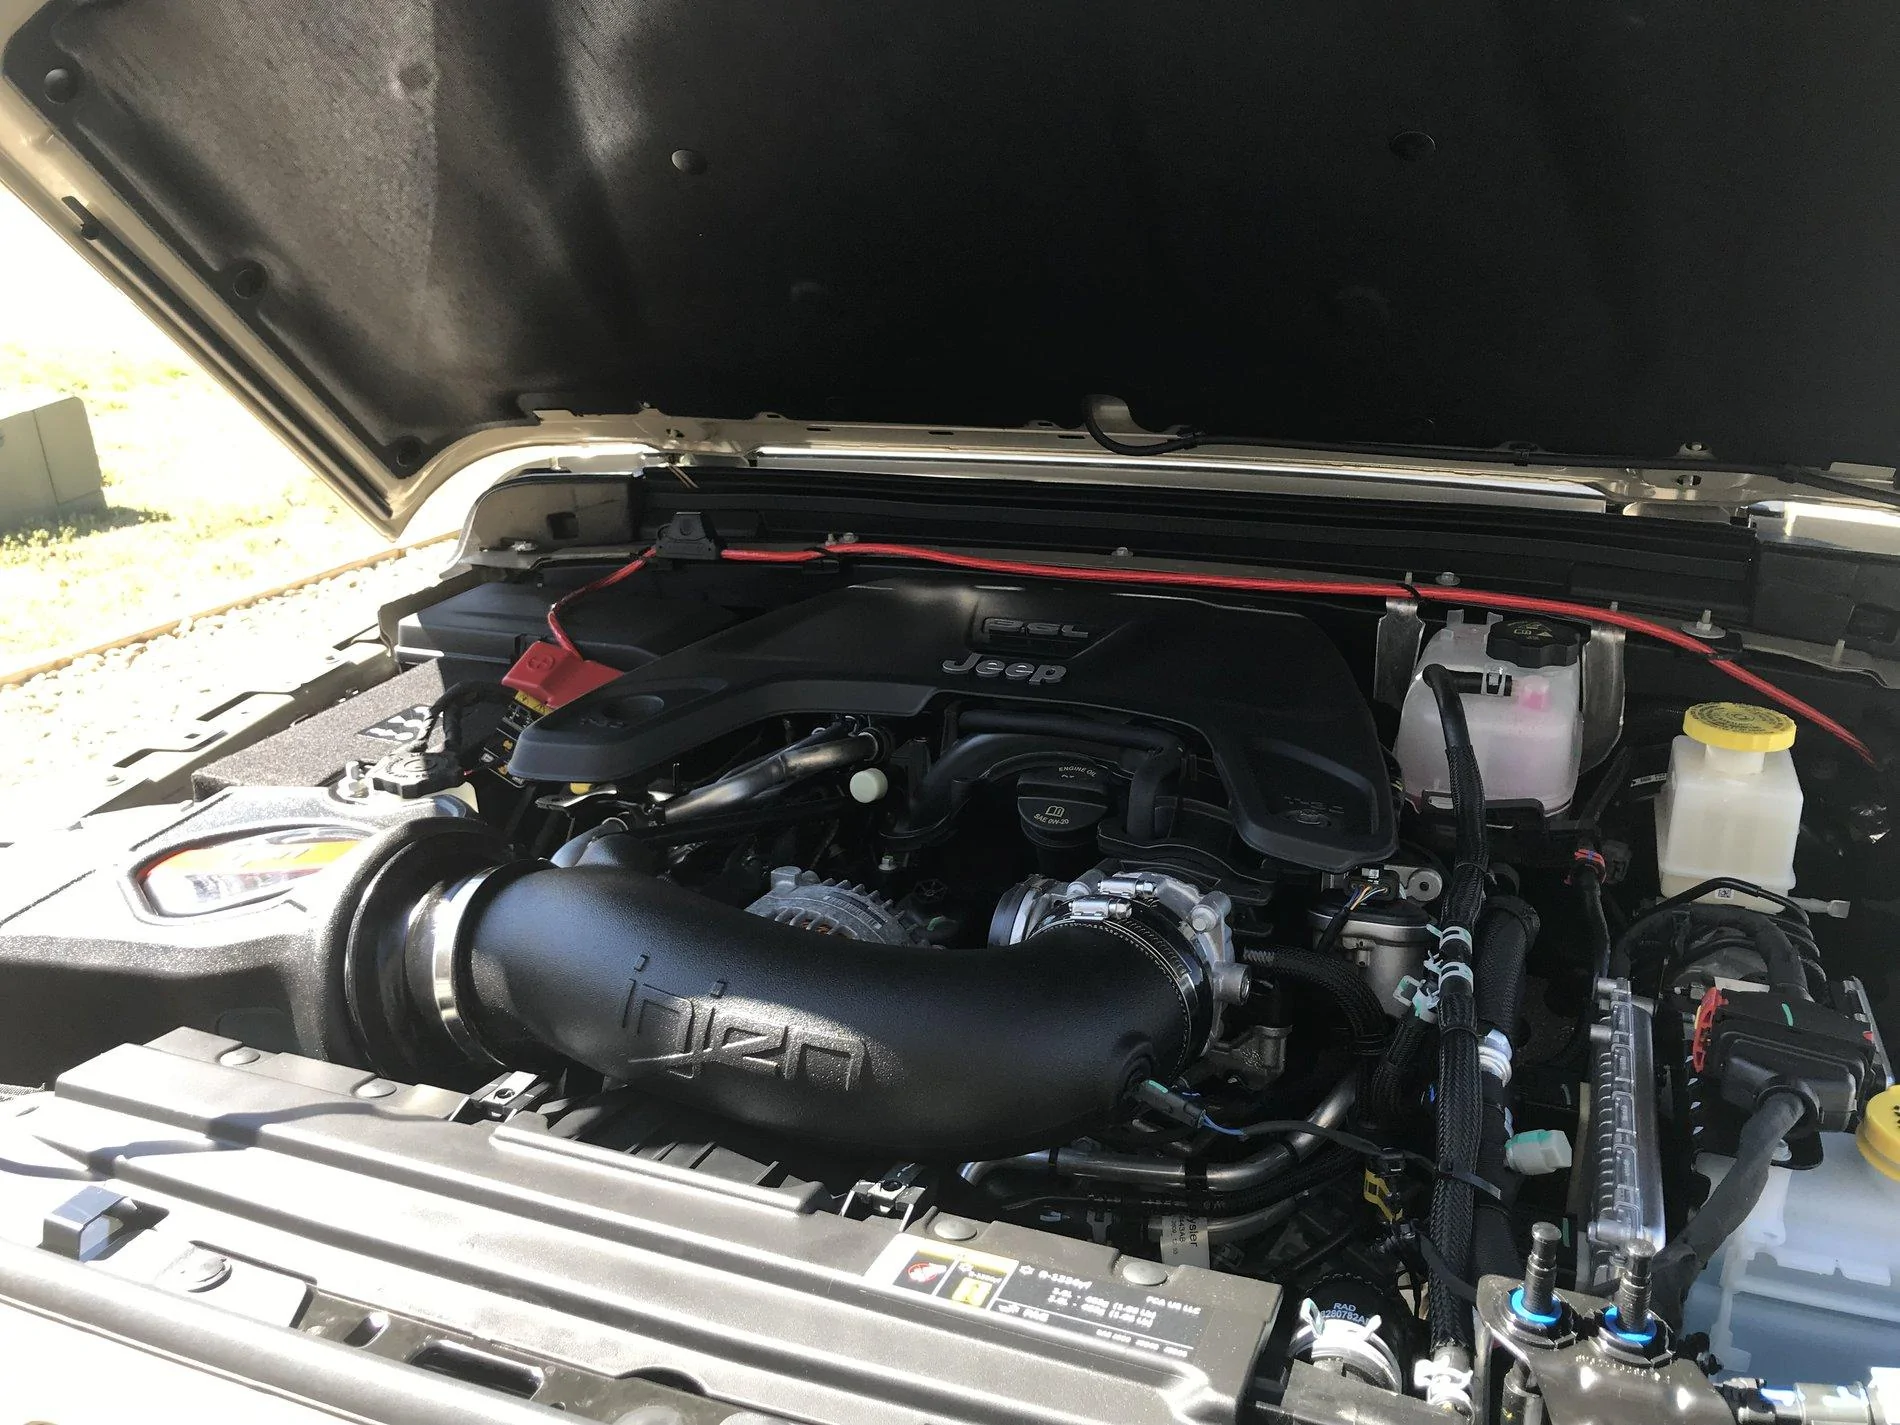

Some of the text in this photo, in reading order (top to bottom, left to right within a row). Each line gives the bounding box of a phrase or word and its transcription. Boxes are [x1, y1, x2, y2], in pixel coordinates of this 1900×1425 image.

[941, 652, 1067, 685] Jeep
[1058, 765, 1097, 778] ENGINE OIL
[1033, 813, 1047, 824] SAE
[1333, 1302, 1357, 1312] RAD
